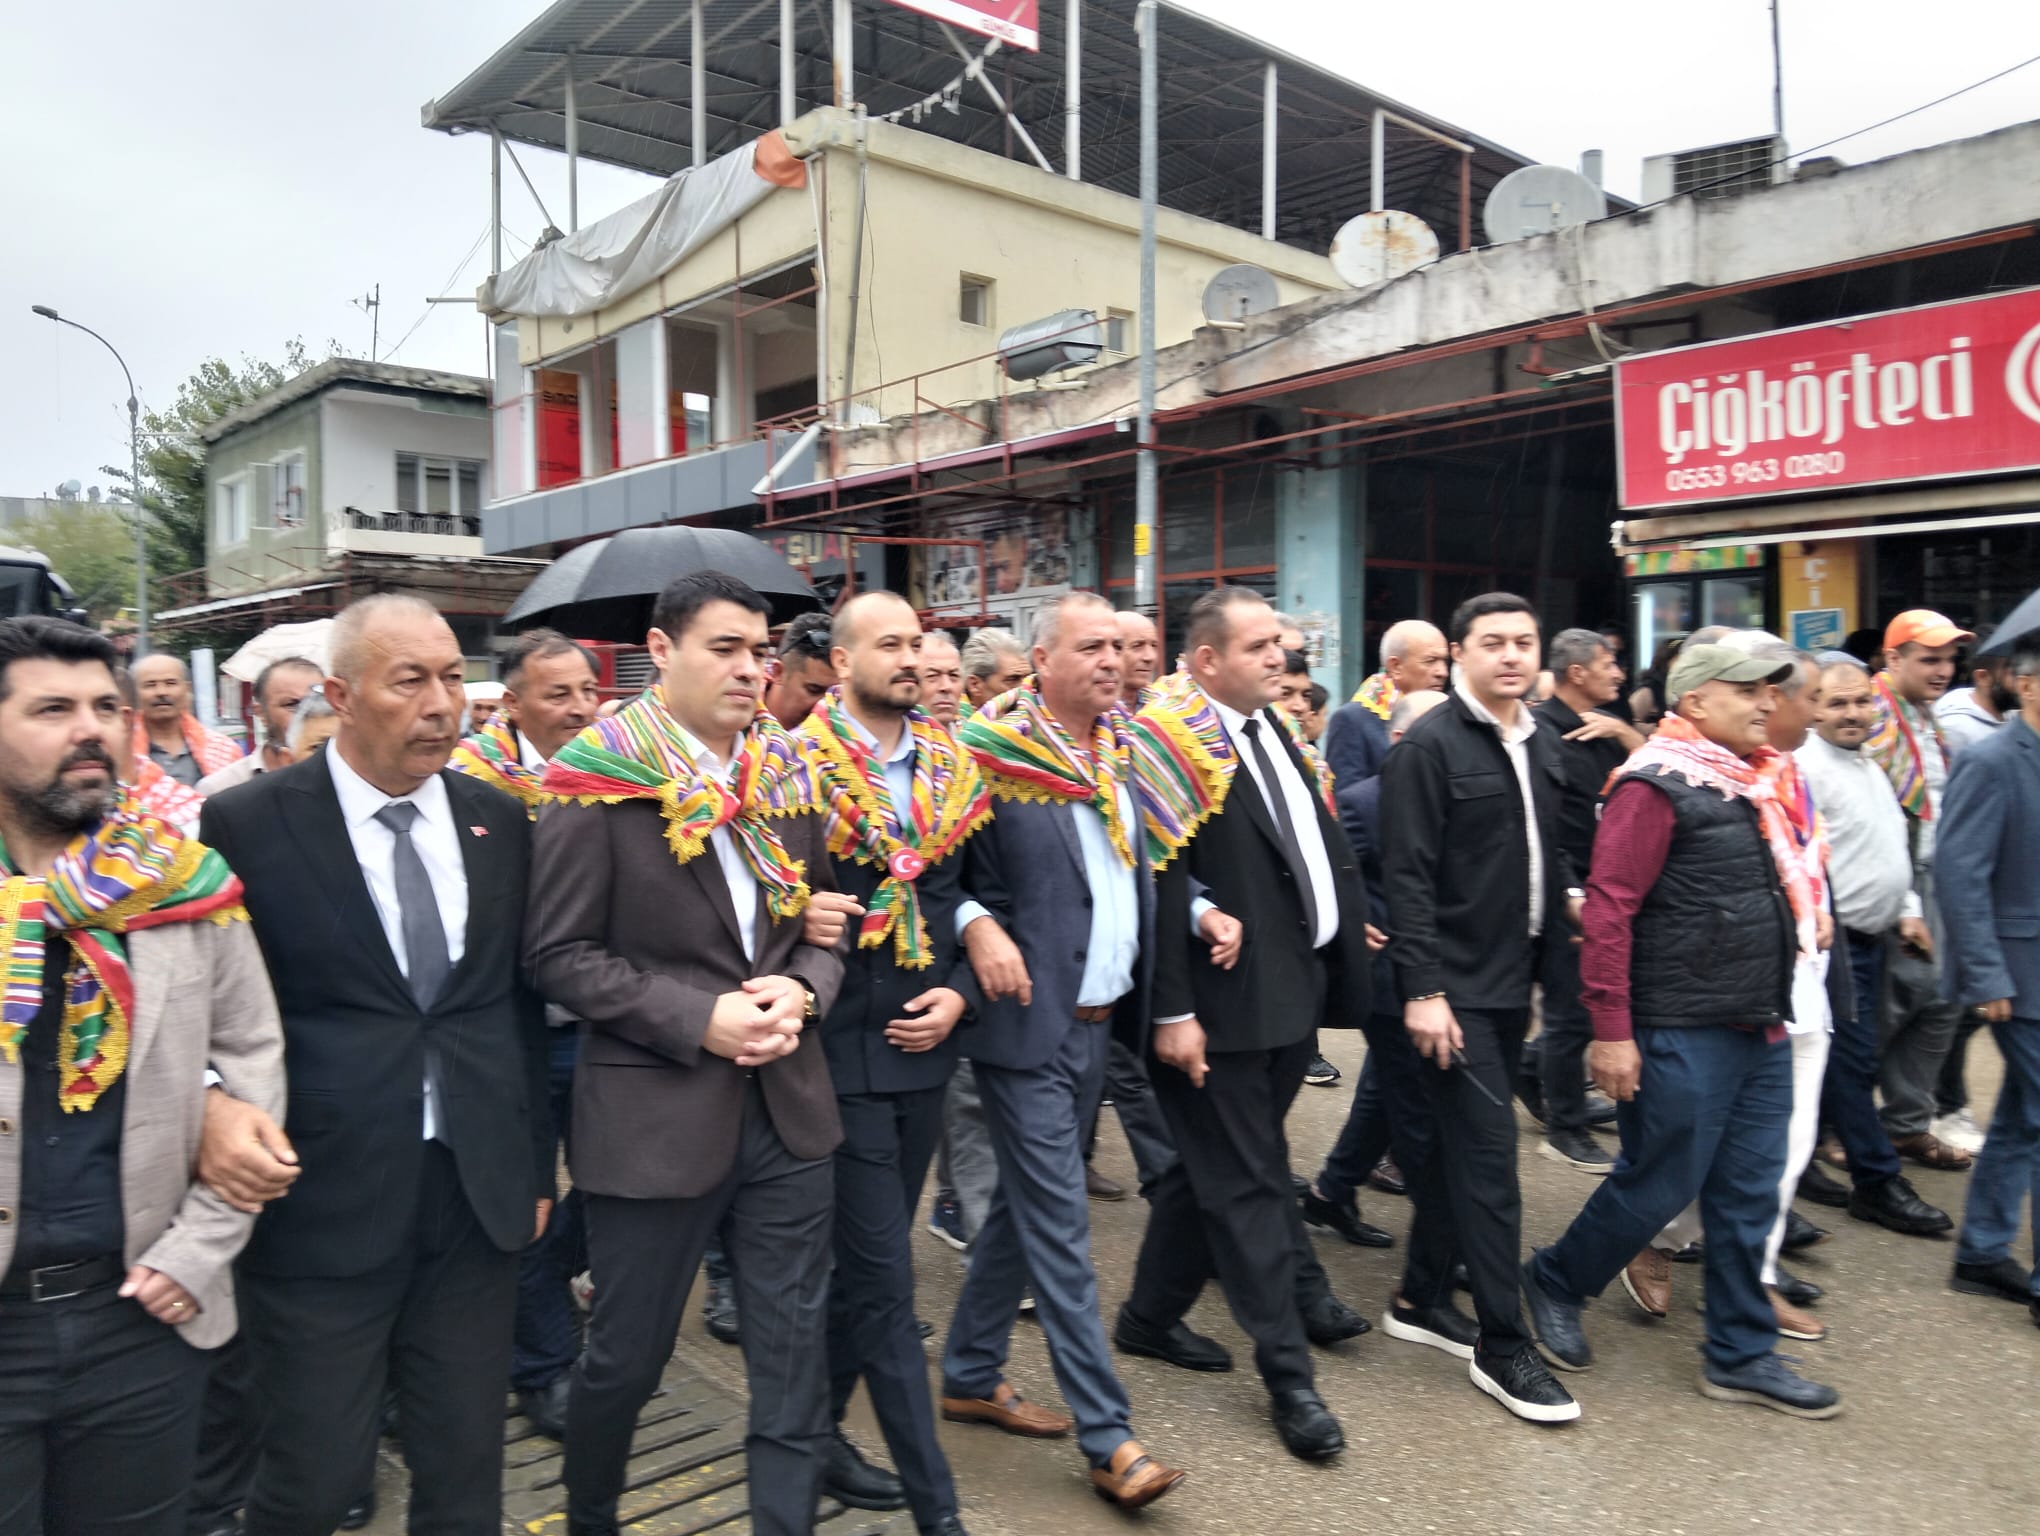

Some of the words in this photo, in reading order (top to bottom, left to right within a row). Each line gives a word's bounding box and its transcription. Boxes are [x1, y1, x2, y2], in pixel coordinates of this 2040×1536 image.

[1659, 336, 1974, 464] Çiğköfteci
[1666, 465, 1727, 491] 0553
[1731, 459, 1780, 484] 963
